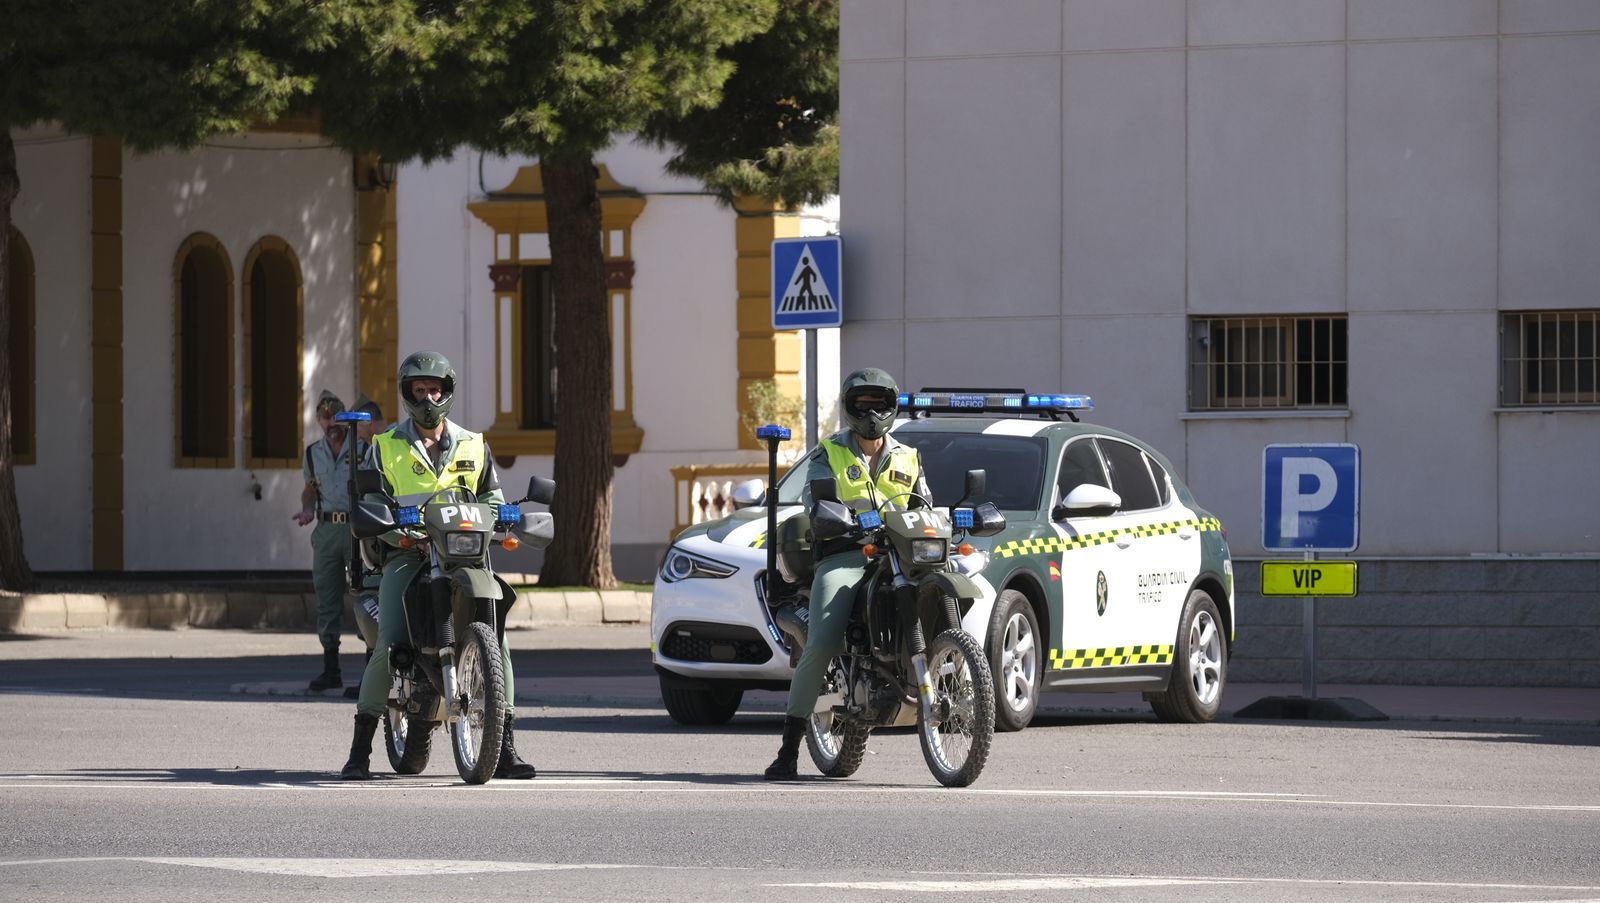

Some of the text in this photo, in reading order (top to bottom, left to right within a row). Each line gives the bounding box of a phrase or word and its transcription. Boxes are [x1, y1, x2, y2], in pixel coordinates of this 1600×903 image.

[951, 400, 984, 408] TRAFICO
[1280, 457, 1338, 538] P
[440, 504, 483, 524] PM
[901, 510, 944, 530] PM
[1138, 571, 1187, 588] GUARDIA CIVIL
[1293, 568, 1322, 588] VIP
[1138, 590, 1162, 603] TRAFICO
